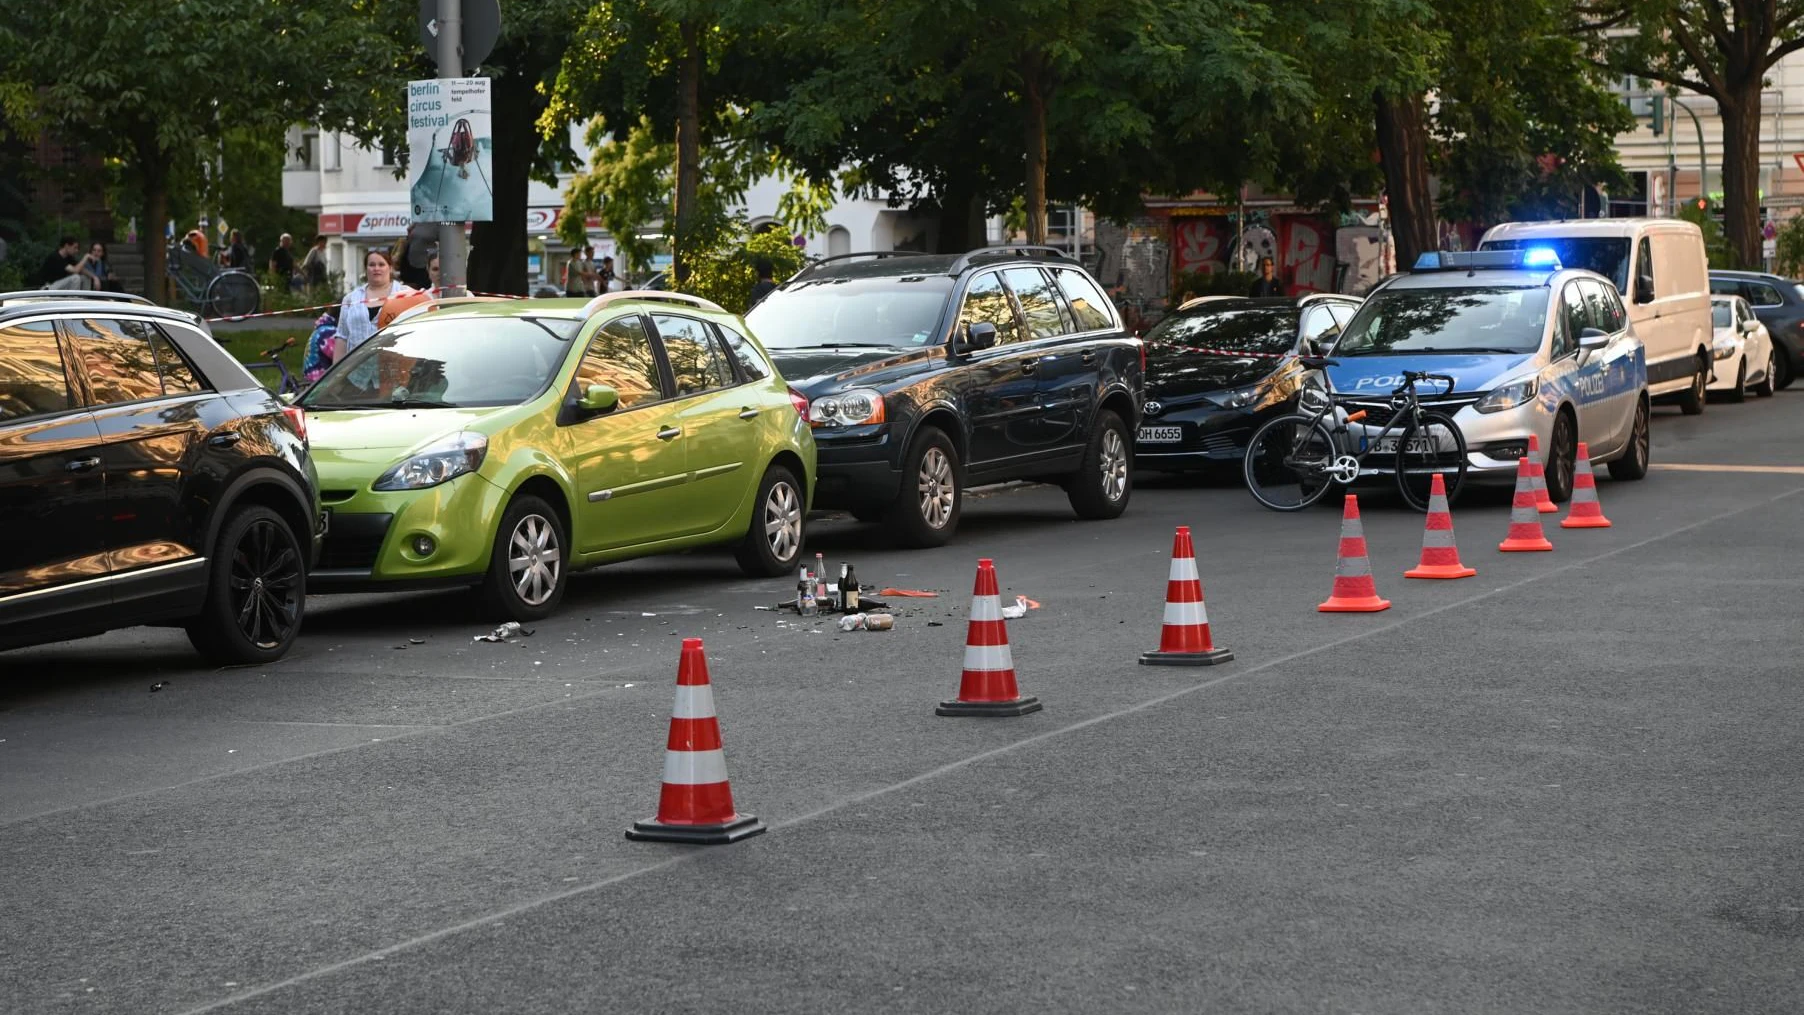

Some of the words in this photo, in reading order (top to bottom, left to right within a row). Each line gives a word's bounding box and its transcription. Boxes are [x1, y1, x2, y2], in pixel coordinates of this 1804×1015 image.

[411, 82, 439, 96] berlin
[410, 99, 442, 112] circus
[411, 113, 449, 128] festival
[1154, 428, 1181, 440] 6655
